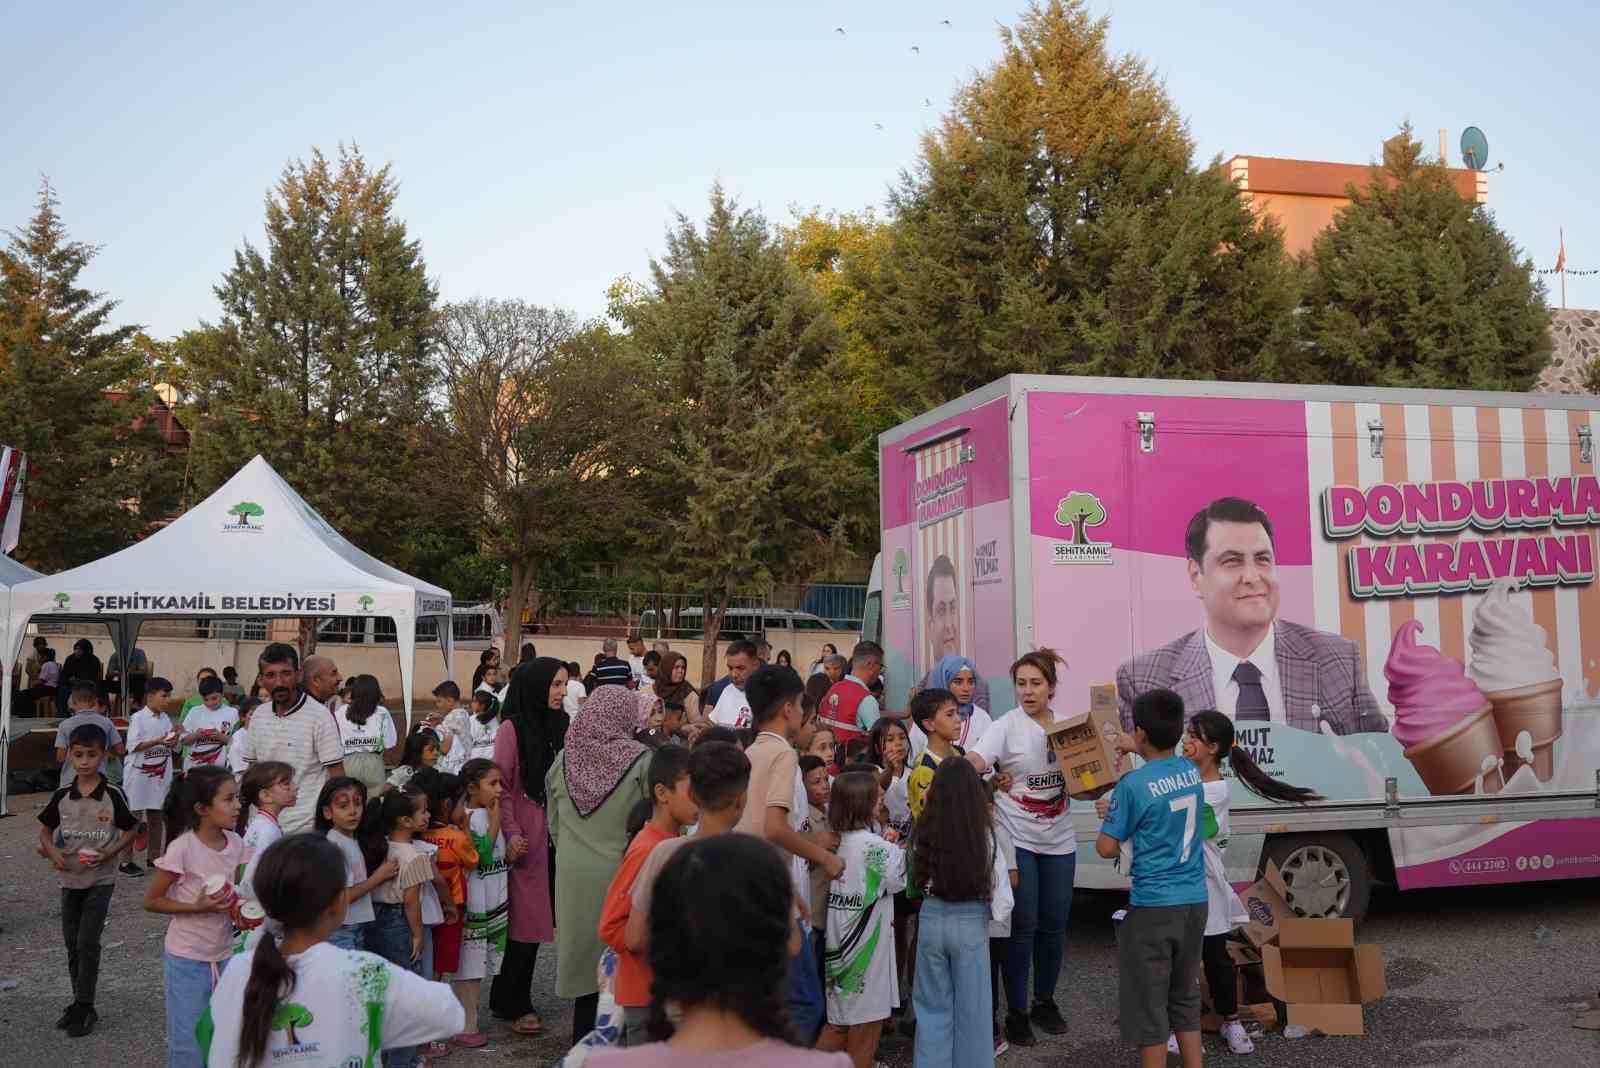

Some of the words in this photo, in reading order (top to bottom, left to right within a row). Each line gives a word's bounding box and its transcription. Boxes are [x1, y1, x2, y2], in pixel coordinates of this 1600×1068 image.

[1325, 475, 1600, 534] DONDURMA
[1351, 533, 1594, 594] KARAVANI
[93, 592, 215, 613] ŞEHİTKAMİL
[221, 593, 336, 611] BELEDİYESİ
[1235, 727, 1271, 746] MUT
[1169, 794, 1198, 864] 7
